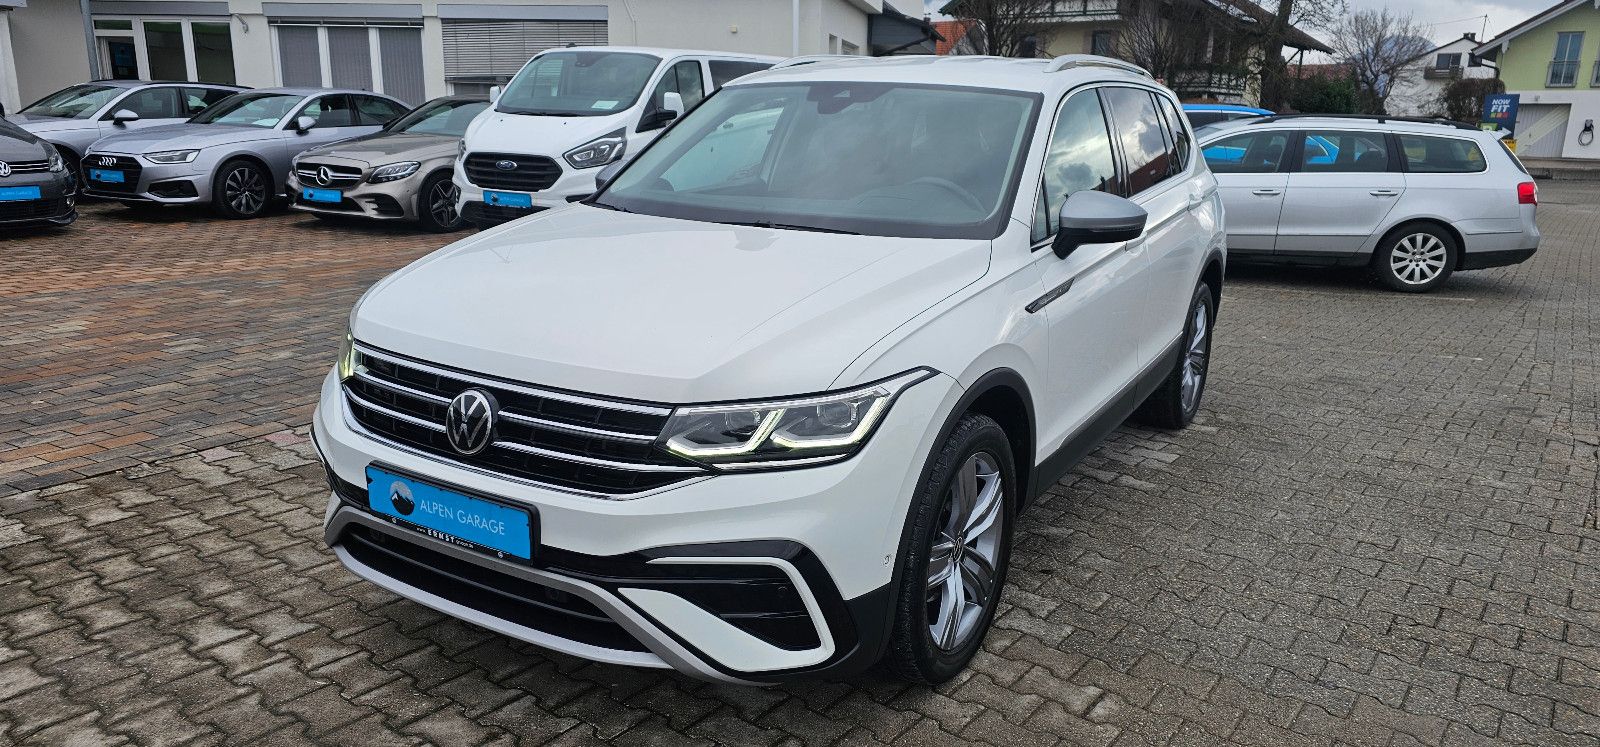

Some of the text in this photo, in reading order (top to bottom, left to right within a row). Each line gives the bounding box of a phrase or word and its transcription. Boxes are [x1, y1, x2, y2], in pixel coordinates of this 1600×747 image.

[420, 500, 505, 535] ALPEN GARAGE
[428, 529, 455, 543] ERNST
